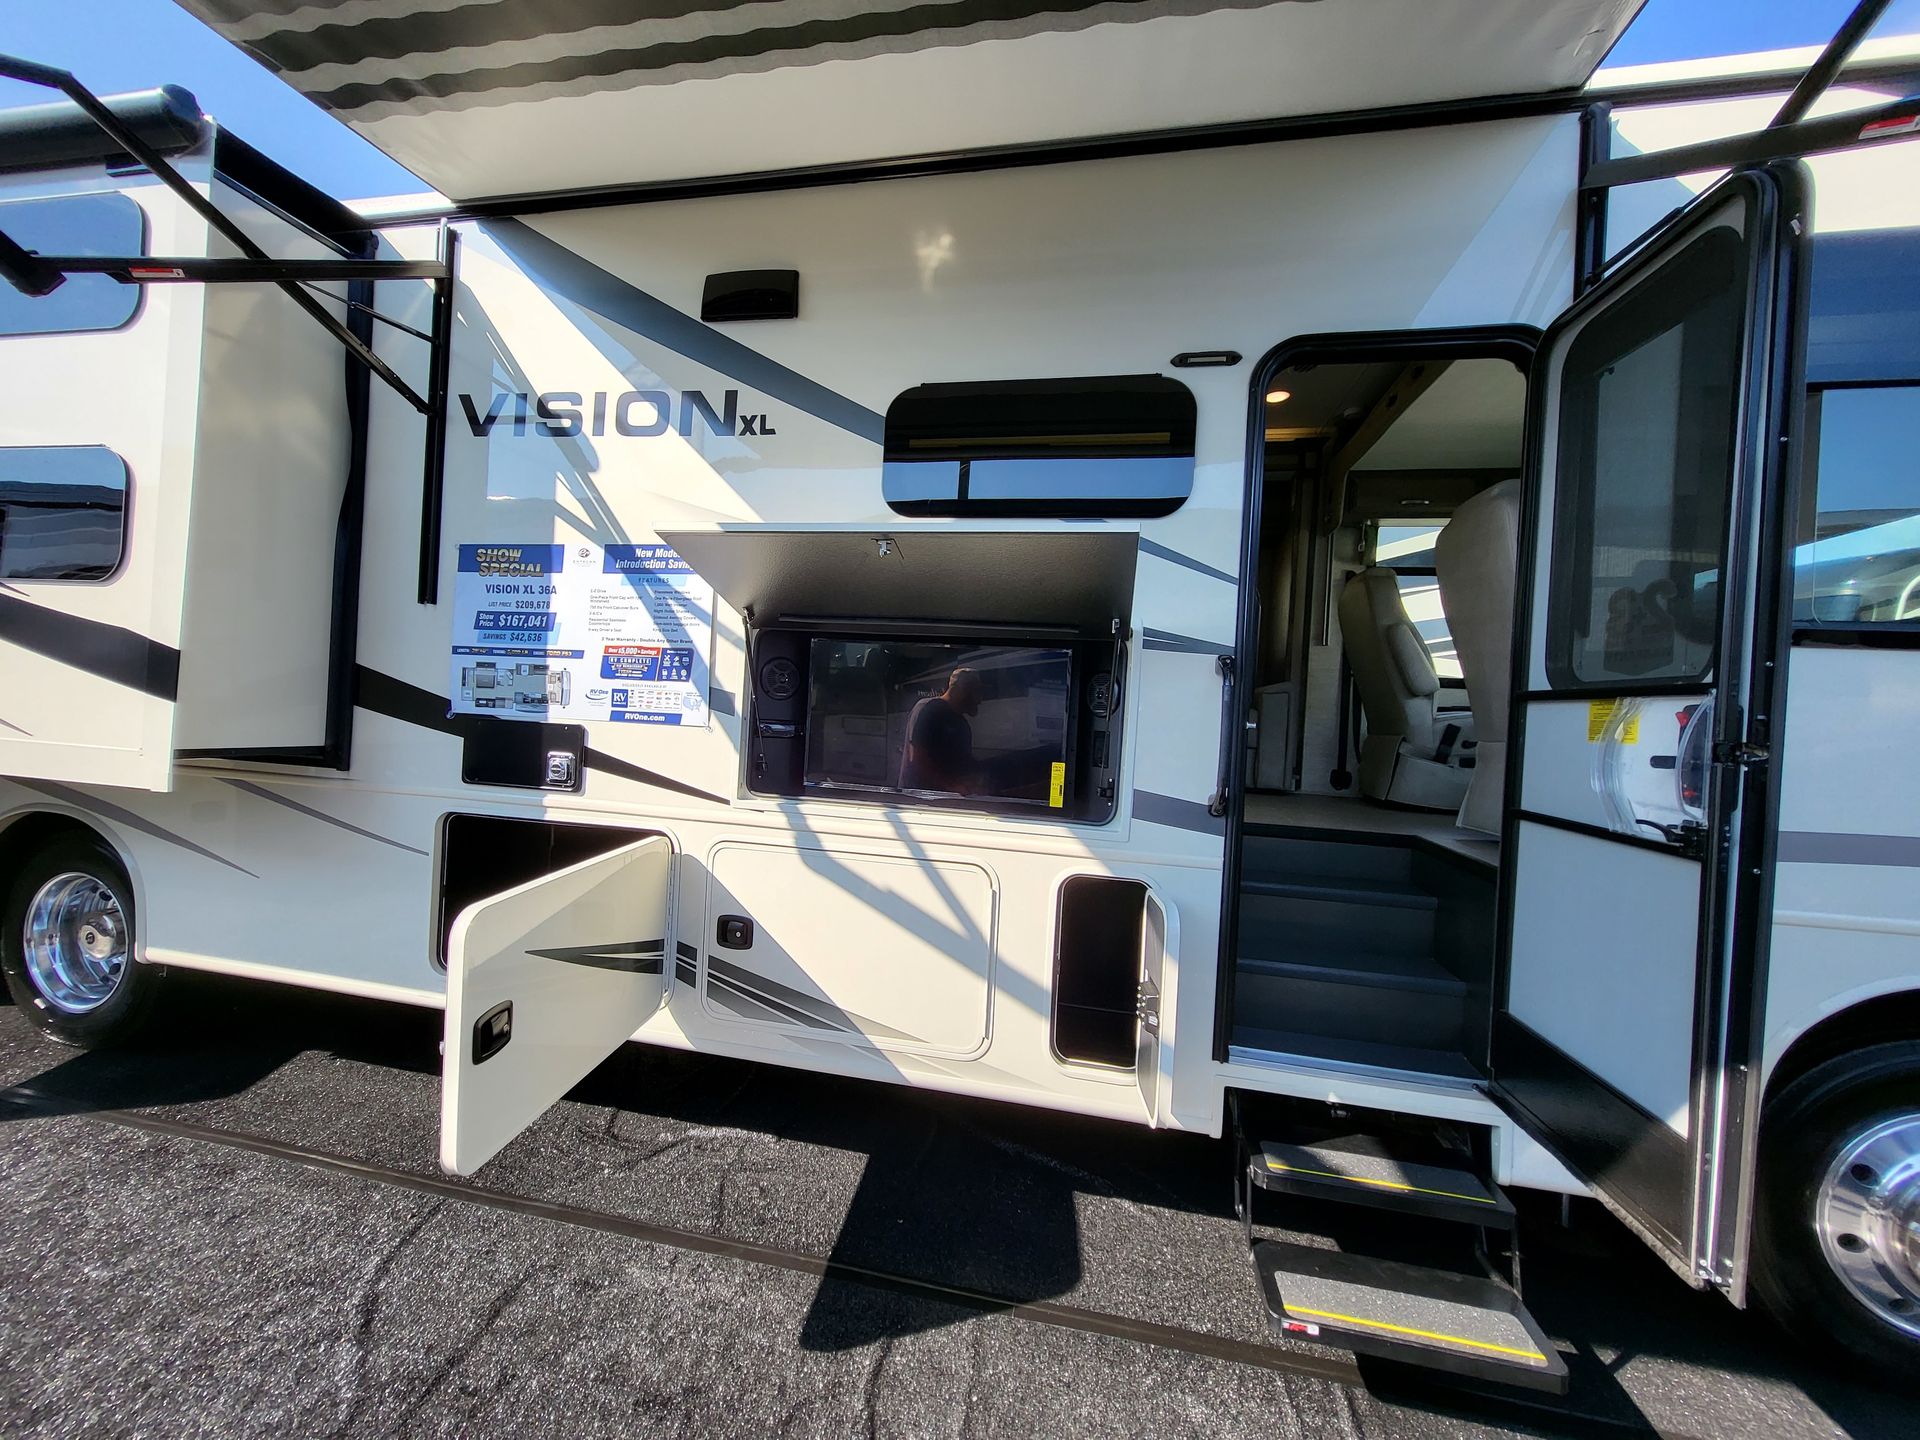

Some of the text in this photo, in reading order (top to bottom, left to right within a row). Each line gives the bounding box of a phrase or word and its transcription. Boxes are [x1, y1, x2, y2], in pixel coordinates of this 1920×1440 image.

[458, 389, 777, 437] VISION XL
[476, 548, 522, 562] SHOW
[634, 548, 681, 558] New Mode
[616, 559, 666, 569] Introduction
[479, 562, 544, 577] SPECIAL
[485, 584, 557, 595] VISION XL 36A
[515, 600, 551, 610] $209,678
[499, 614, 548, 629] $167,041
[510, 632, 542, 642] $42,636
[613, 692, 628, 702] RV
[624, 713, 666, 722] RVOne.com
